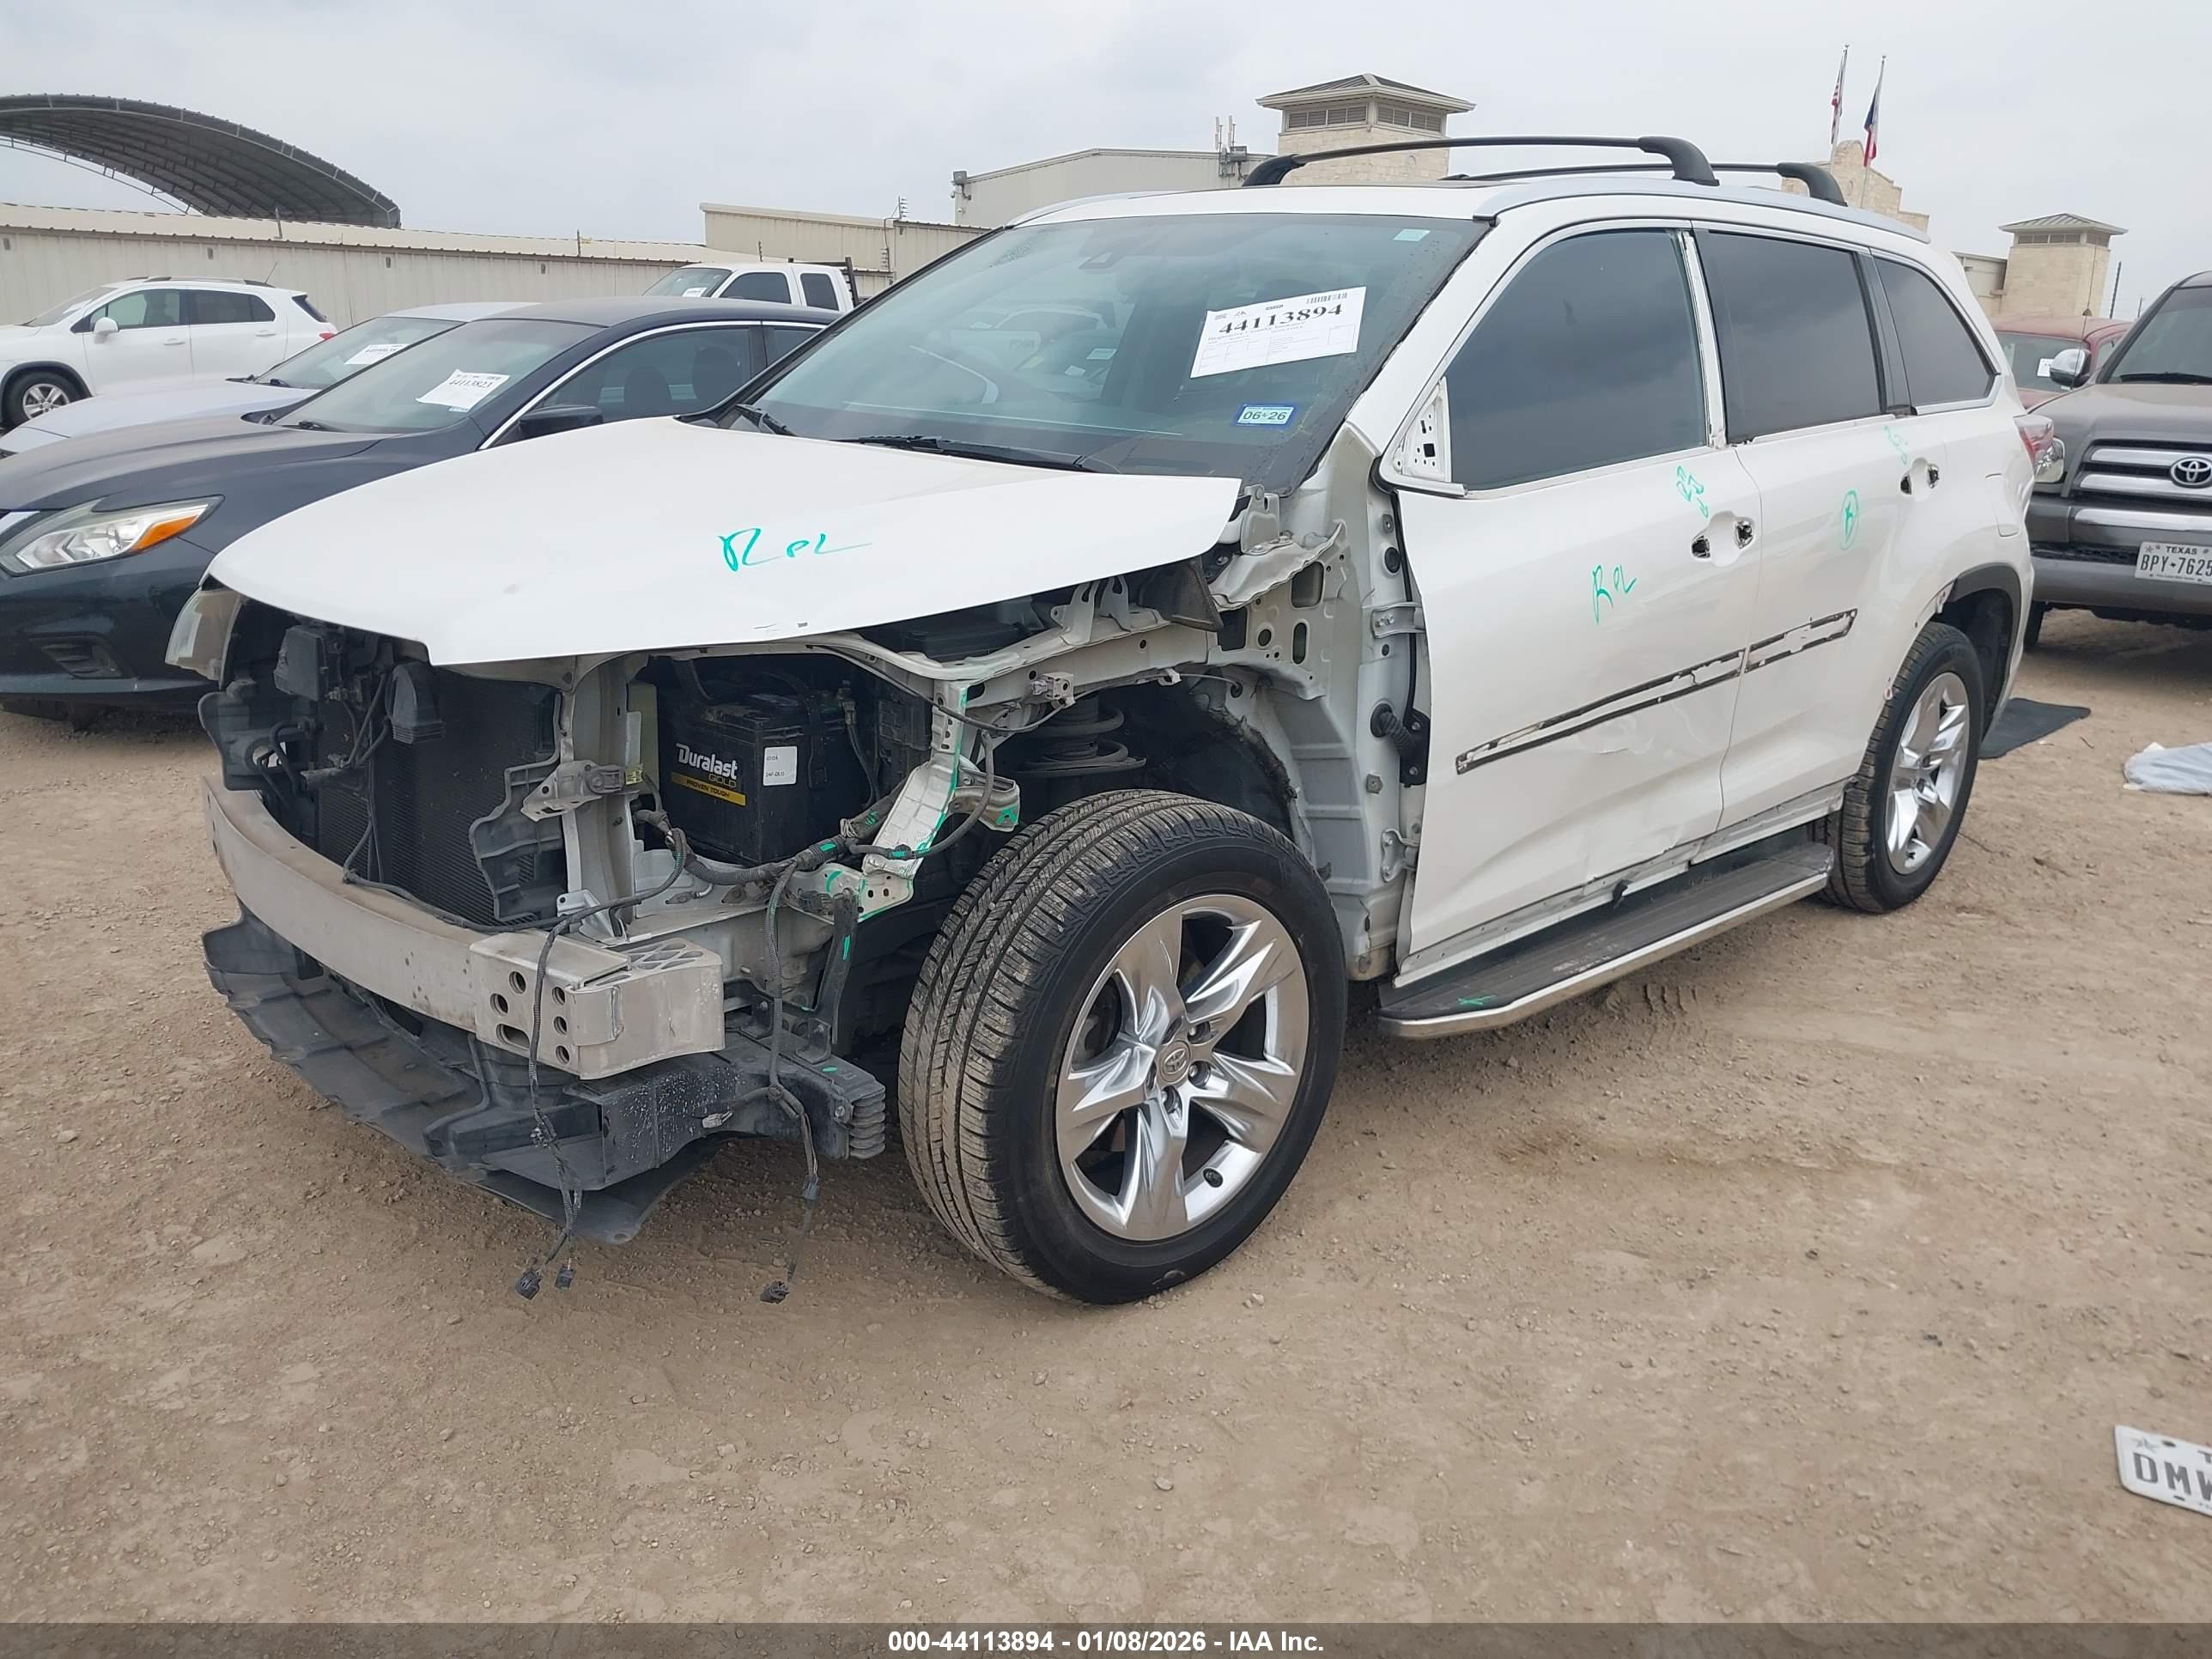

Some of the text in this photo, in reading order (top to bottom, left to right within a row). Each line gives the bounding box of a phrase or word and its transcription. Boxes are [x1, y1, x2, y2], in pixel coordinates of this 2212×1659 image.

[1218, 303, 1343, 334] 44113894
[2166, 545, 2197, 555] TEXAS
[676, 743, 738, 780] Duralast
[687, 780, 731, 798] PROVEN TOUGH
[708, 773, 737, 788] GOLD
